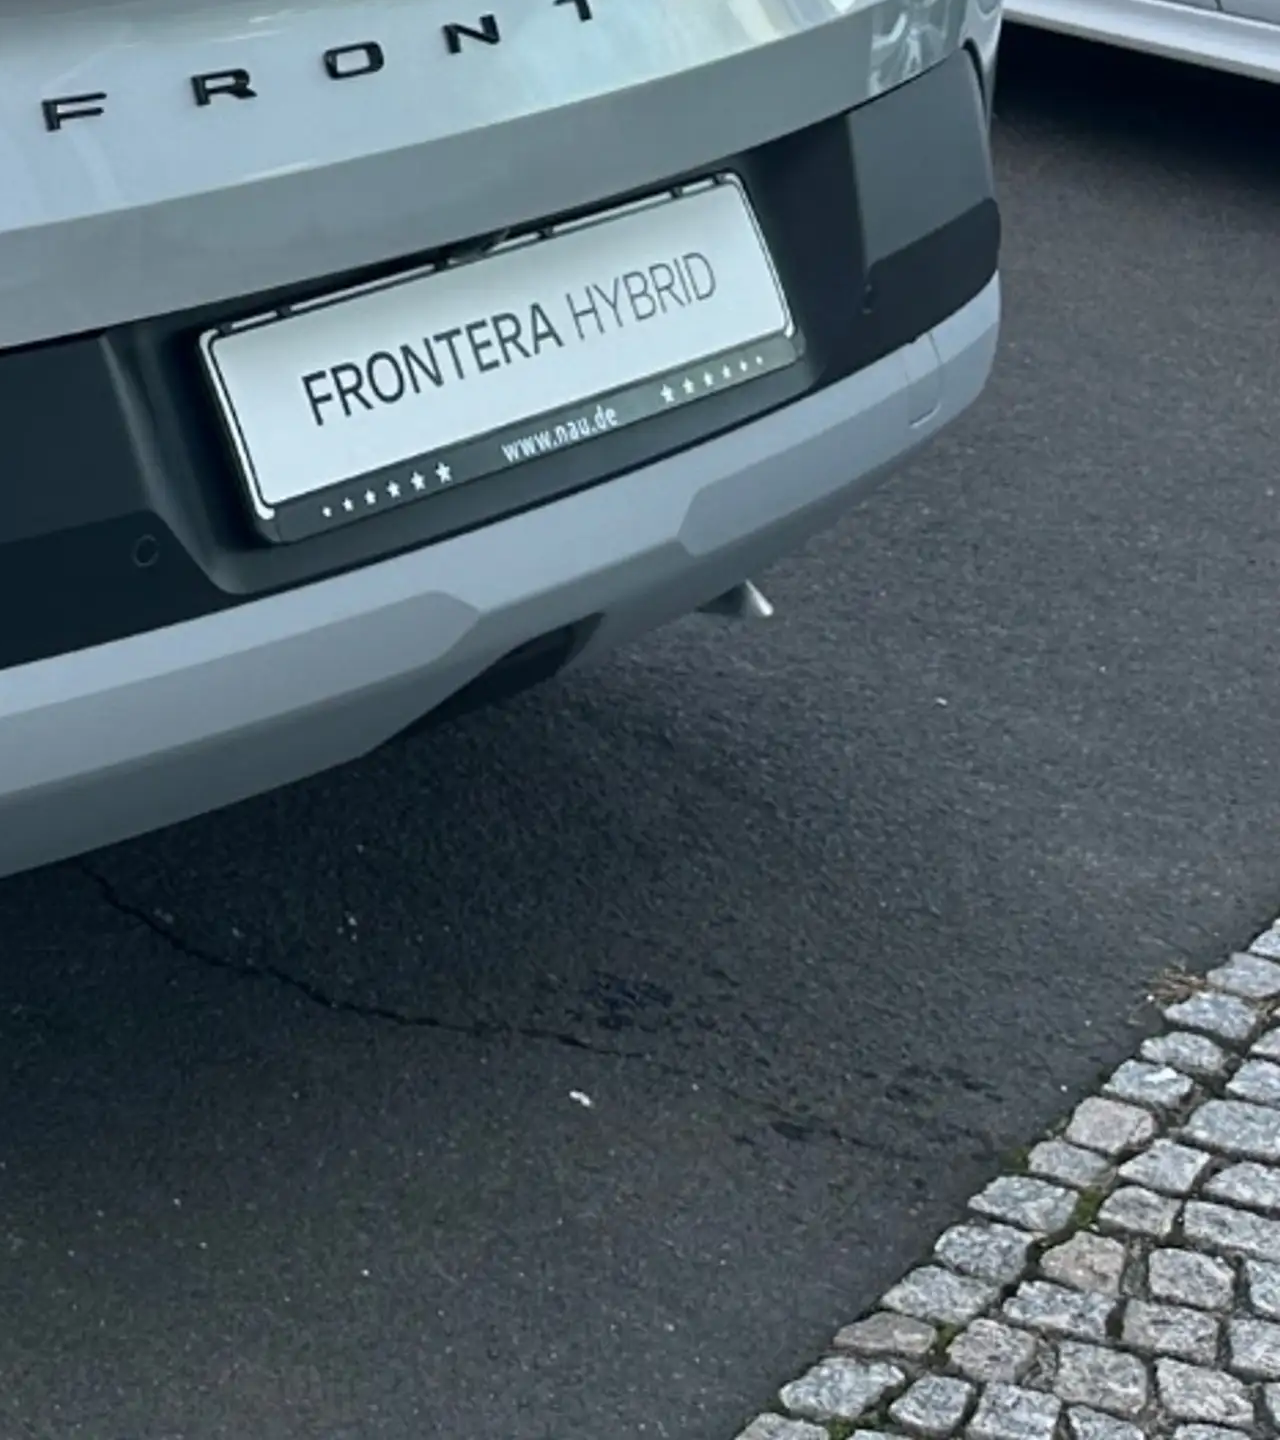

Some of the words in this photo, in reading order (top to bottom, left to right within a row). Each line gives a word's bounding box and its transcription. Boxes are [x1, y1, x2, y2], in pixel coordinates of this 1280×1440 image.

[302, 302, 564, 426] FRONTERA
[566, 252, 717, 341] HYBRID
[501, 404, 618, 463] www.nau.de
